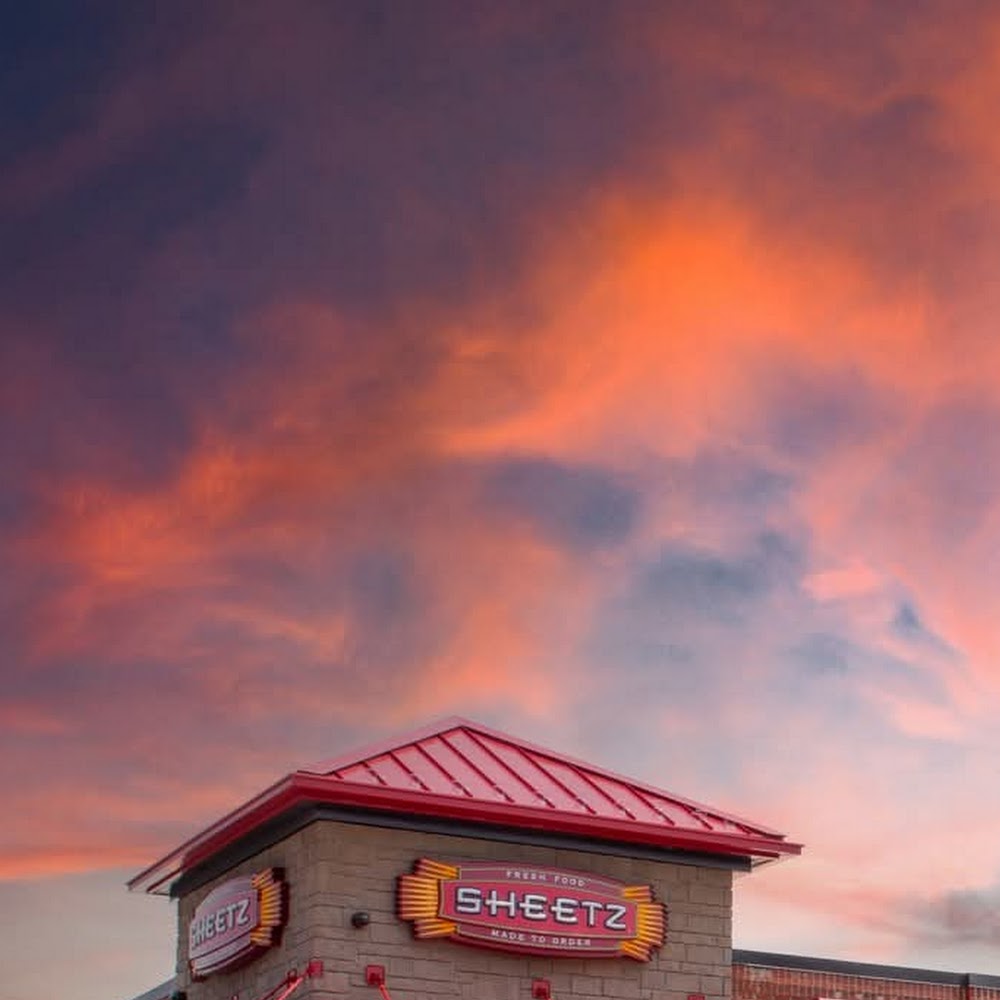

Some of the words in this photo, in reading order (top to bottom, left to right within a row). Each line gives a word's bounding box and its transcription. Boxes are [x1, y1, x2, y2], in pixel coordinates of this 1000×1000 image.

[506, 871, 547, 881] FRESH
[554, 875, 586, 887] FOOD
[456, 887, 627, 930] SHEETZ
[491, 929, 524, 941] MADE
[531, 935, 546, 944] TO
[552, 937, 591, 946] ORDER
